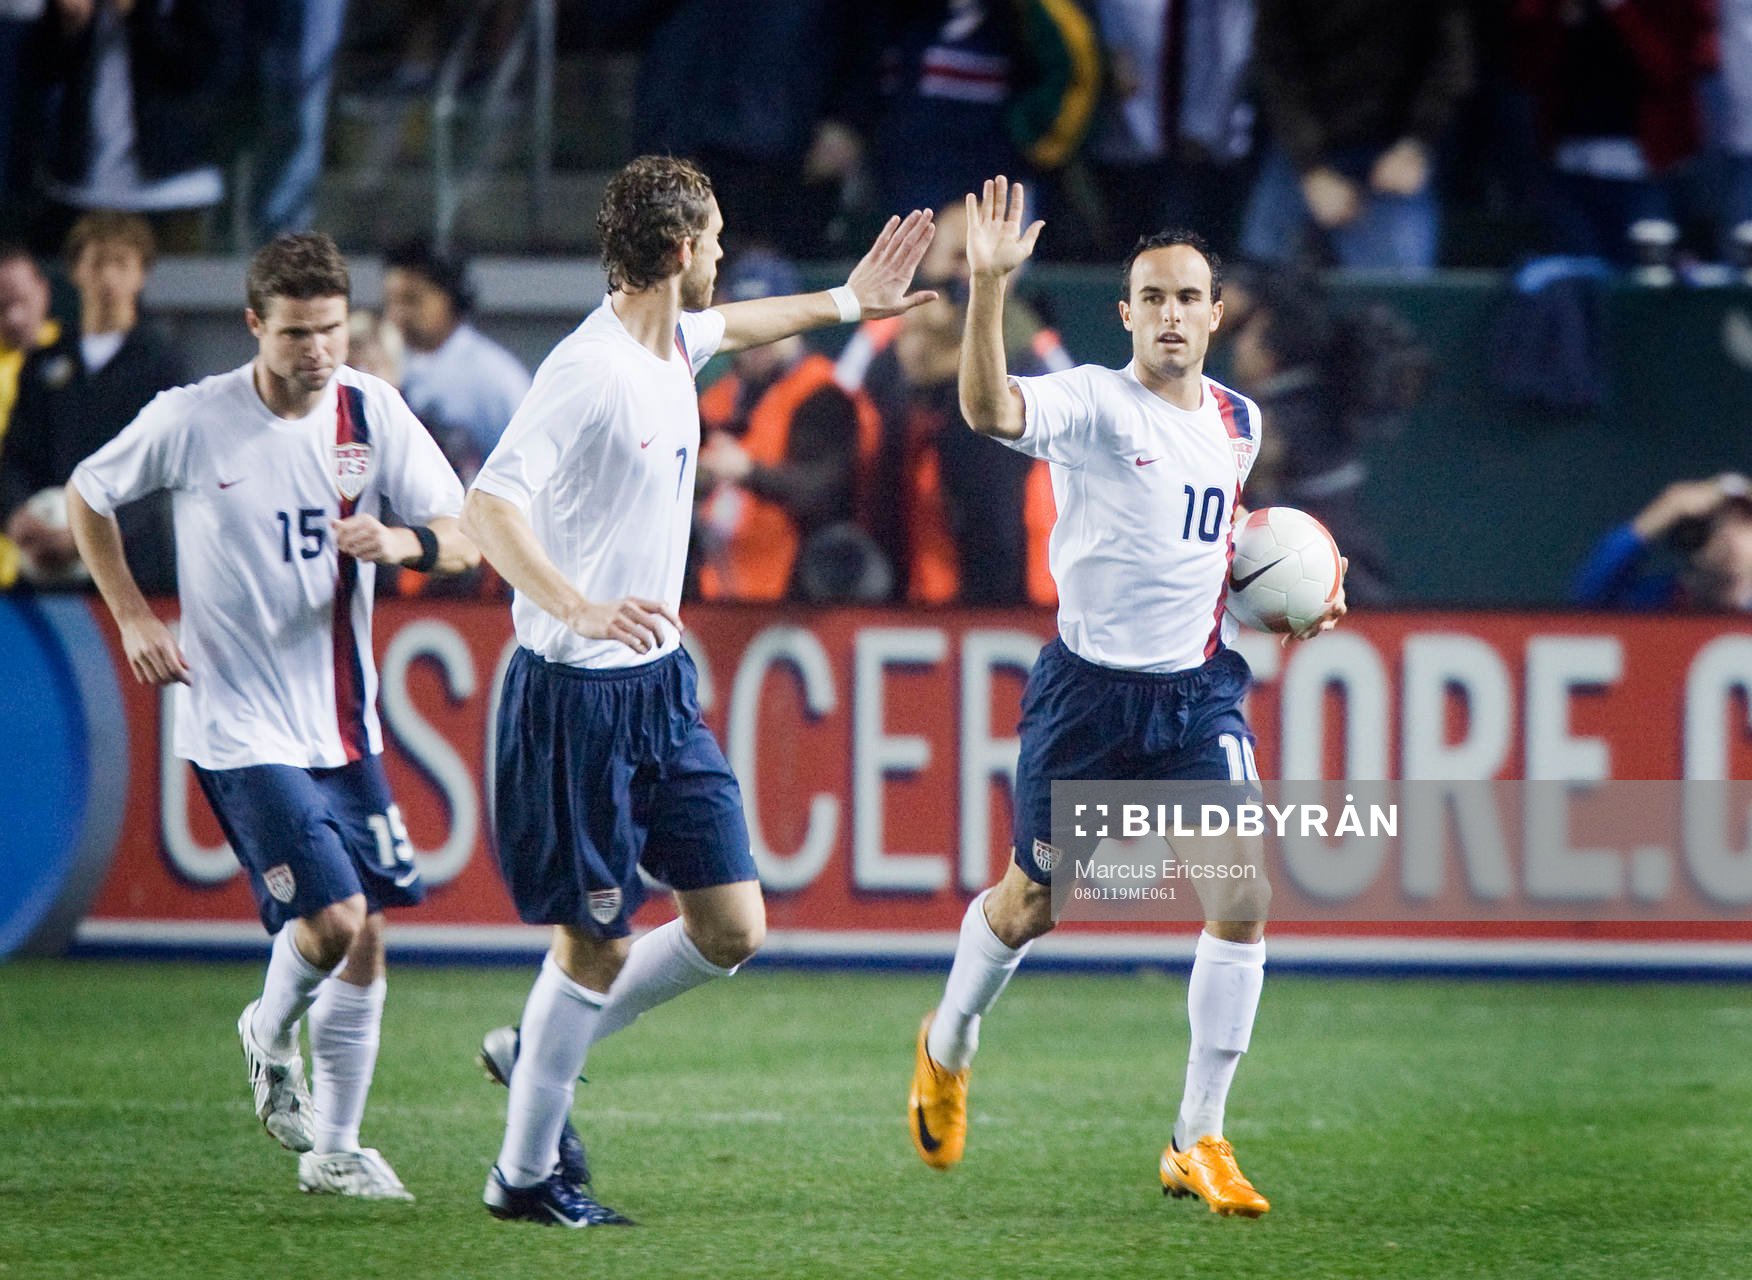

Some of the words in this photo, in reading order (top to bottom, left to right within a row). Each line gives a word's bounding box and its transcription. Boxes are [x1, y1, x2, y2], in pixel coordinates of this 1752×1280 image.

[675, 446, 688, 502] 7
[276, 508, 326, 563] 15
[1182, 484, 1225, 543] 10
